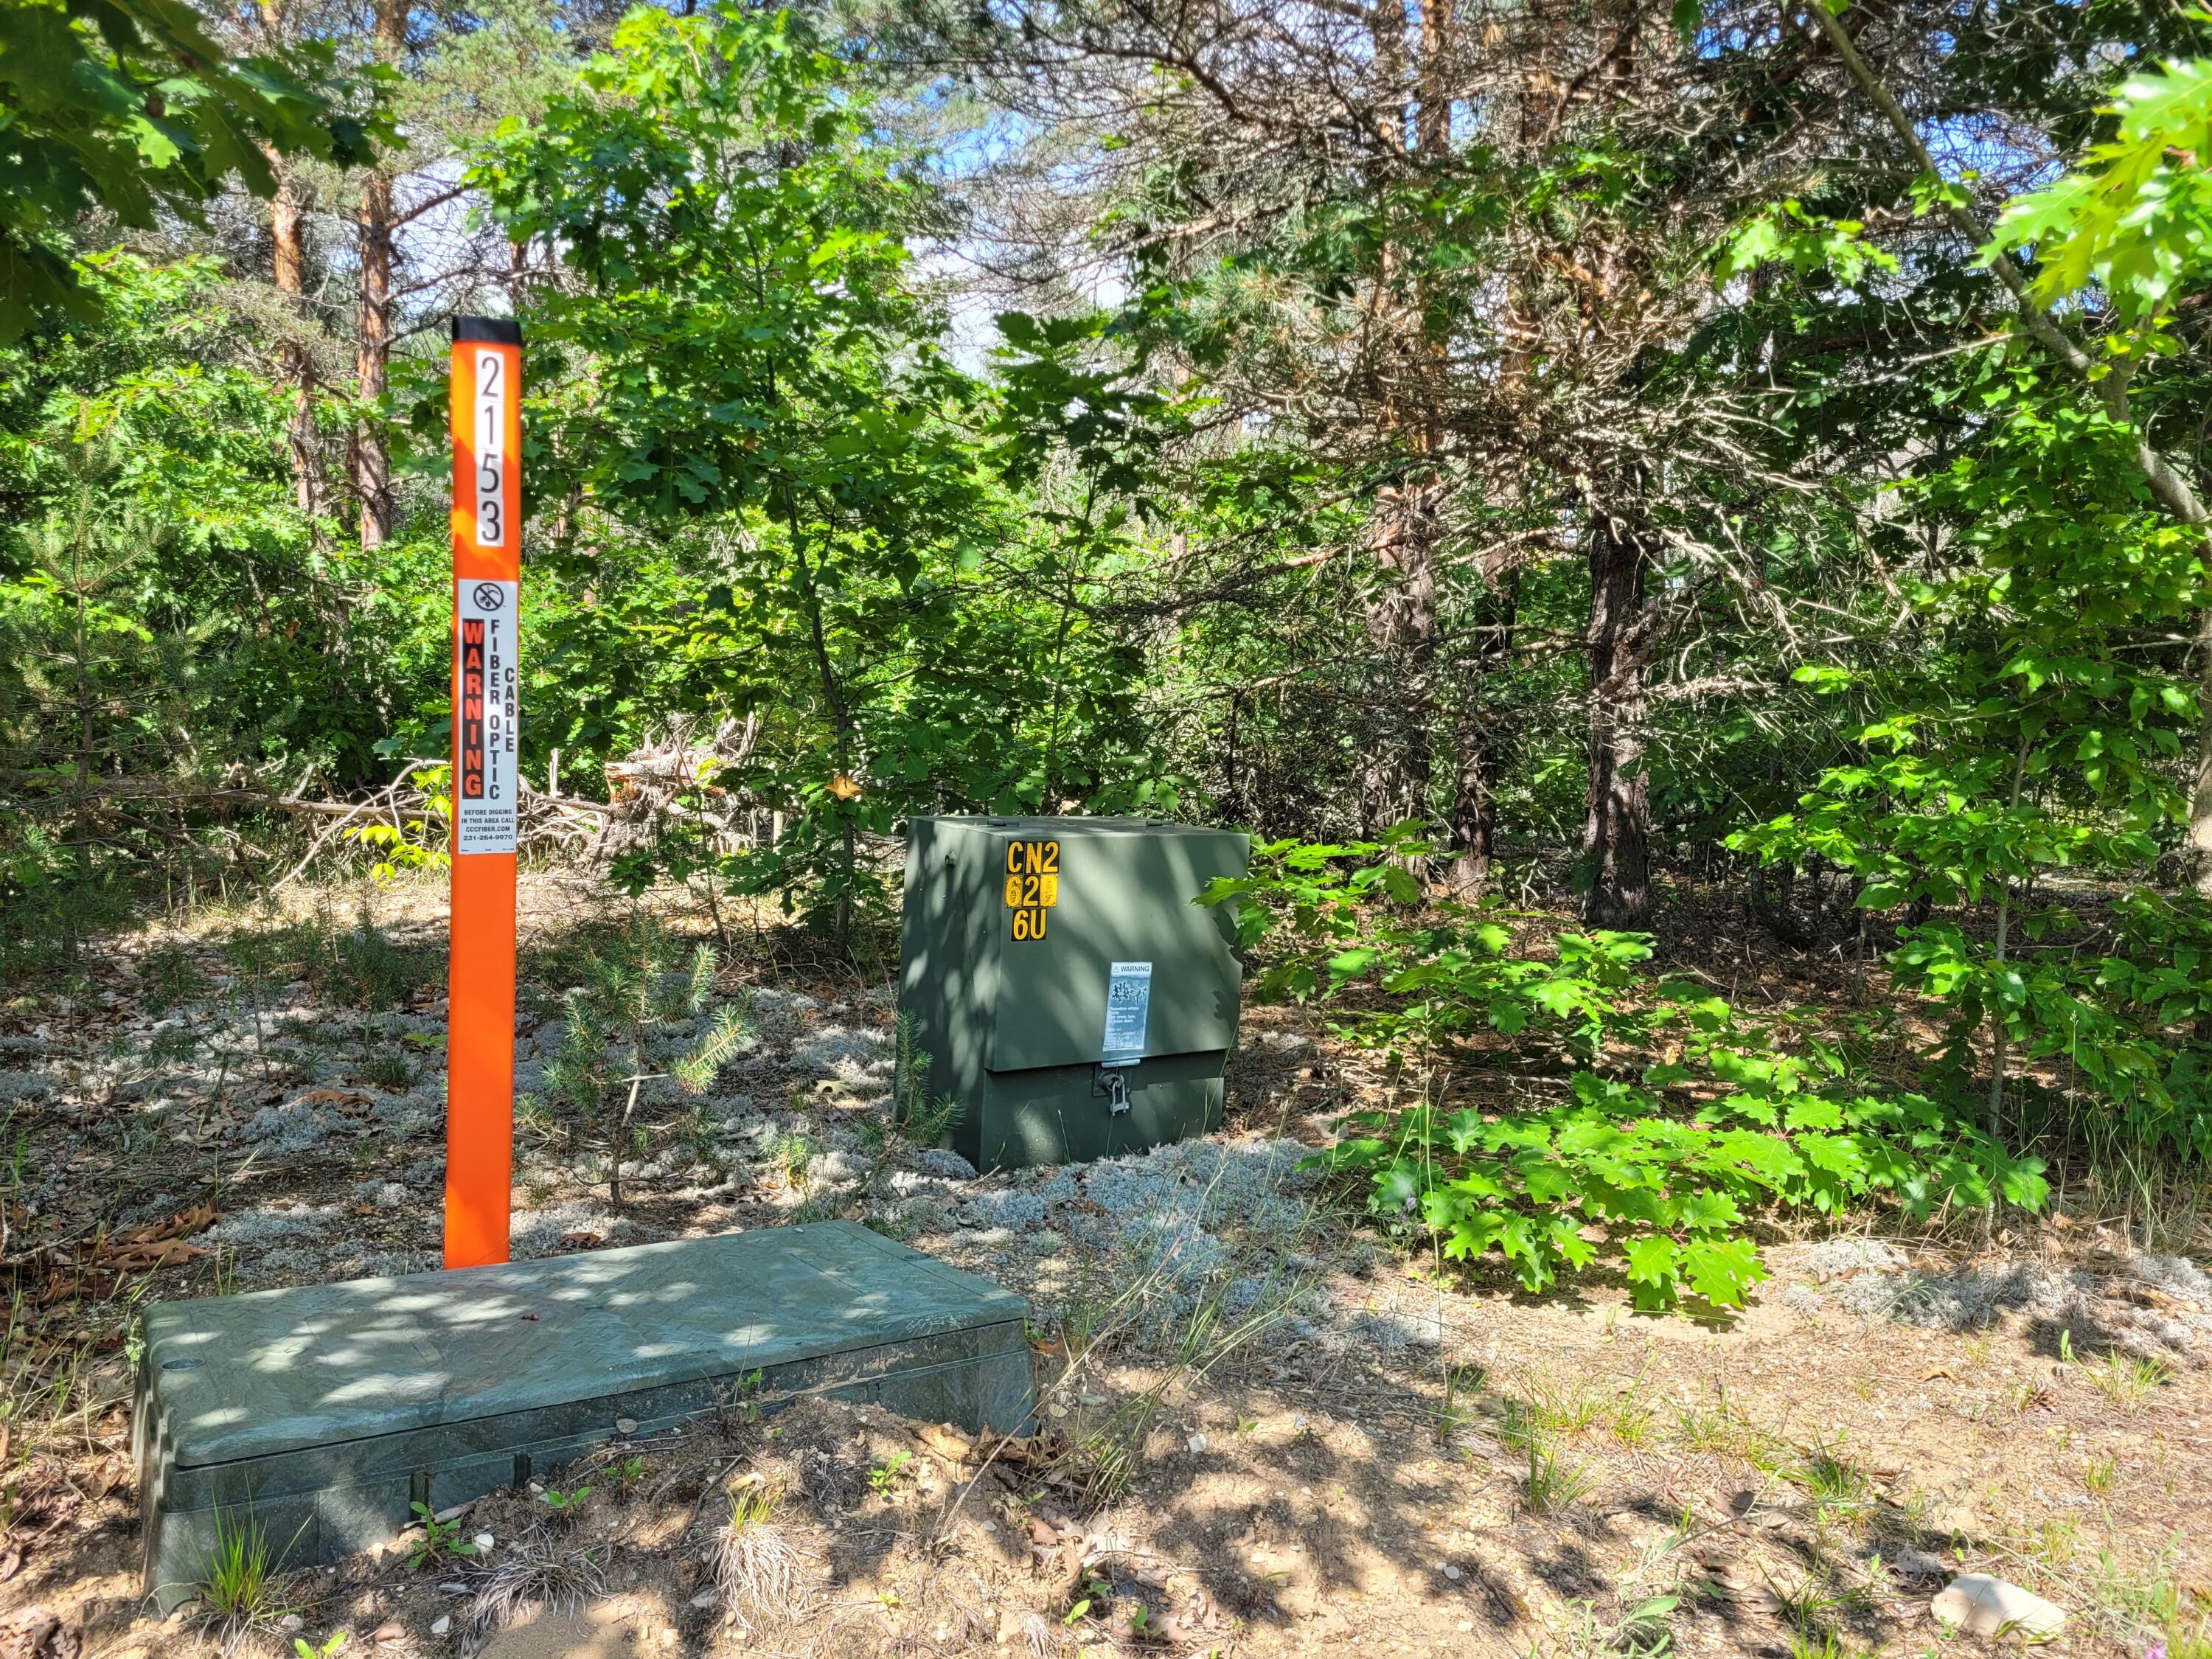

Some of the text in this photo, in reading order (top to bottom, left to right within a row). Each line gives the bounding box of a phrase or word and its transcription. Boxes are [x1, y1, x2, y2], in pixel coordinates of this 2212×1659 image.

[481, 356, 501, 543] 2153
[463, 622, 484, 796] WARNING
[489, 619, 501, 800] FIBER OPTIC
[504, 667, 515, 752] CABLE
[1008, 841, 1059, 873] CN2
[1013, 908, 1046, 940] 6U
